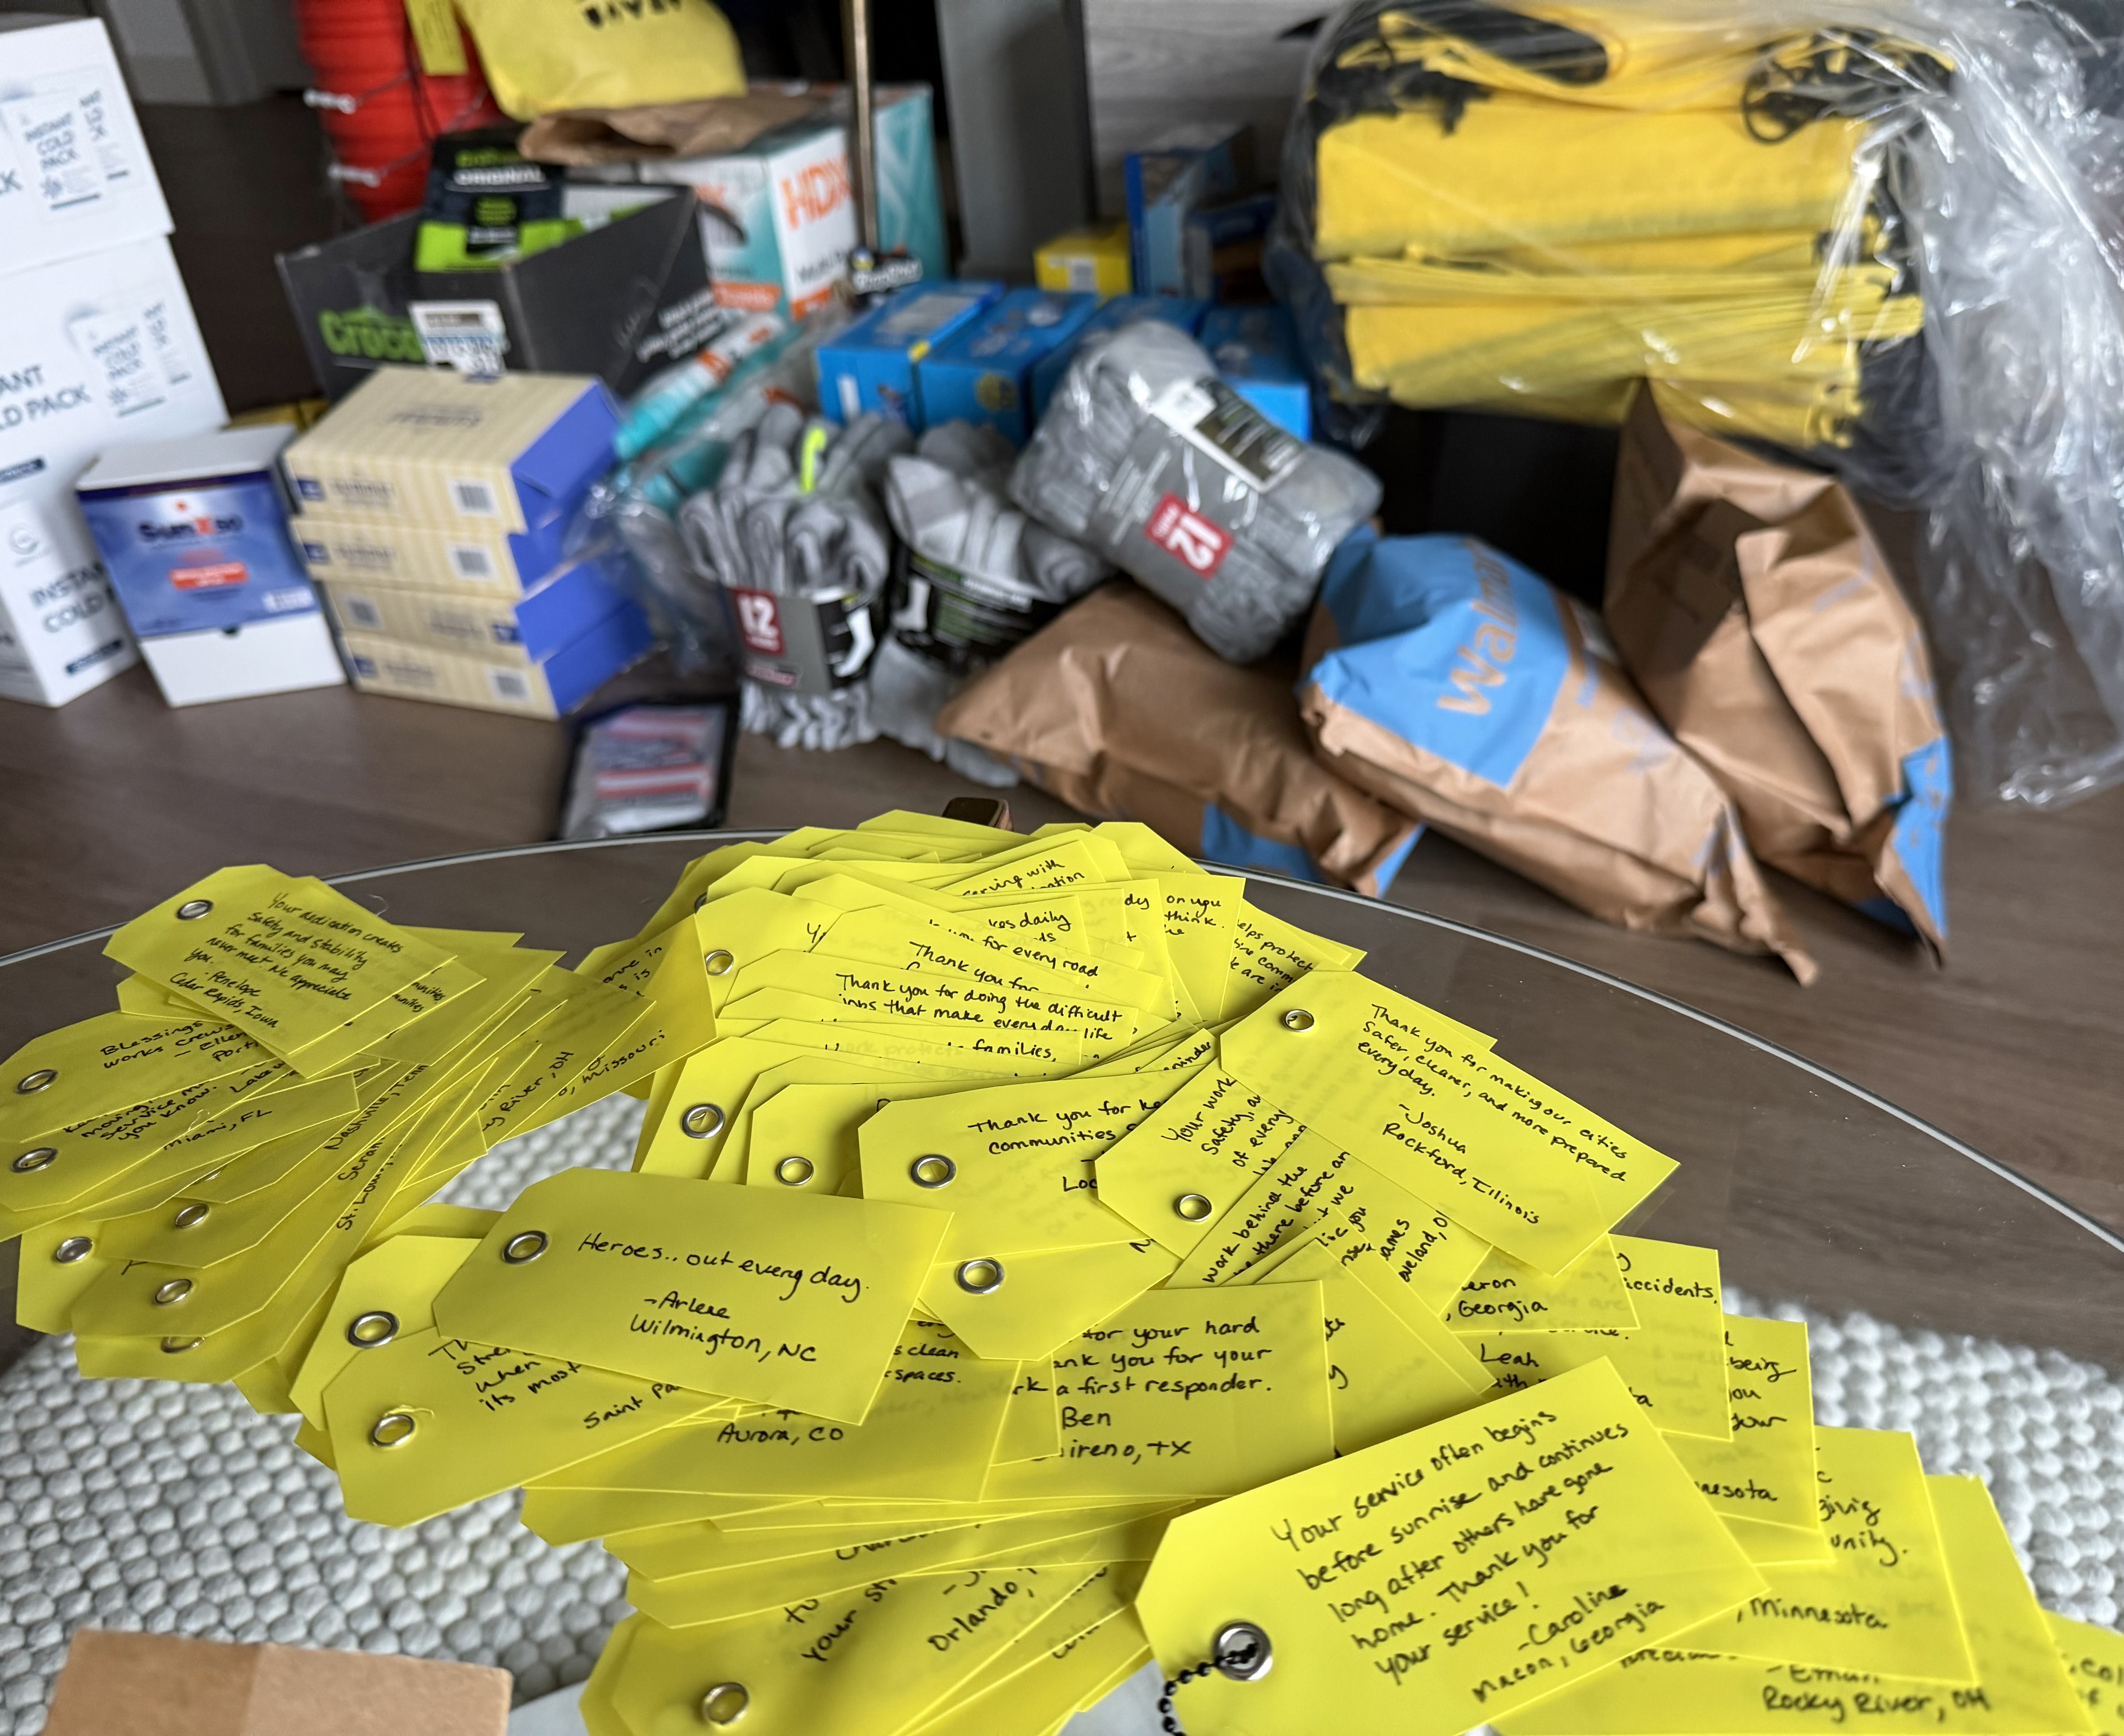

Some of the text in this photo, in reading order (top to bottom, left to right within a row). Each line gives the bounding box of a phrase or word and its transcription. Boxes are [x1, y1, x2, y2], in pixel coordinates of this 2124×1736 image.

[738, 593, 778, 636] 12
[1026, 859, 1065, 877] with
[1166, 895, 1185, 904] on
[271, 894, 403, 953] Your dedication creates
[1019, 911, 1072, 932] daily
[206, 937, 237, 953] never
[290, 975, 352, 1000] appreciate
[225, 924, 348, 982] for families you may
[282, 931, 312, 943] and
[310, 939, 368, 969] stability
[645, 947, 662, 957] in
[909, 941, 1003, 986] Thank you
[982, 935, 1098, 977] for every road
[633, 968, 650, 981] is
[1241, 969, 1265, 984] are
[170, 973, 279, 1028] Cedar Rapids, Iowa
[835, 973, 1123, 1022] Thank you for doing the difficult
[100, 1020, 203, 1056] Blessings
[883, 999, 1113, 1040] that make life
[103, 1023, 237, 1069] works crews
[1373, 1005, 1627, 1159] Thank you for making our cities
[100, 1099, 176, 1140] service
[118, 1122, 157, 1140] you
[157, 1086, 217, 1118] know.
[240, 1110, 272, 1122] FL
[325, 1092, 400, 1150] Nashville,
[967, 1100, 1131, 1133] Thank you for
[1162, 1078, 1238, 1141] Your work
[1415, 1055, 1471, 1097] cleaner,
[1478, 1092, 1508, 1112] and
[1511, 1111, 1549, 1135] more
[1550, 1135, 1626, 1182] prepared
[989, 1129, 1116, 1155] communities
[1382, 1122, 1539, 1224] Rockford, Illinois
[1252, 1219, 1294, 1255] there
[1284, 1171, 1335, 1213] before
[1330, 1185, 1354, 1206] we
[1202, 1243, 1240, 1283] work
[1232, 1191, 1282, 1239] behind
[1277, 1166, 1308, 1187] the
[1380, 1220, 1410, 1261] ames
[686, 1251, 734, 1266] out
[1458, 1300, 1548, 1322] Georgia
[630, 1314, 816, 1363] Wilmington, NC
[907, 1343, 959, 1359] clean
[1132, 1327, 1190, 1349] your
[1205, 1316, 1260, 1335] hard
[895, 1369, 961, 1383] spaces.
[1111, 1346, 1272, 1373] you for your
[1480, 1343, 1539, 1368] Leah
[475, 1361, 541, 1393] when
[479, 1361, 582, 1411] its most
[1056, 1372, 1271, 1400] a first responder.
[583, 1396, 643, 1429] Saint
[1062, 1406, 1111, 1430] Ben
[717, 1422, 844, 1446] Aurora, CO
[1274, 1411, 1557, 1550] Your service often begins
[1297, 1424, 1628, 1590] before sunrise and continues
[1328, 1462, 1613, 1623] long after others have gone
[1351, 1505, 1598, 1649] home. Thank you for
[927, 1583, 1034, 1651] Orlando,
[1443, 1583, 1539, 1647] service!
[1518, 1585, 1628, 1650] -Caroline
[1571, 1602, 1665, 1653] Georgia
[1750, 1598, 1887, 1629] Minnesota
[1763, 1686, 1845, 1723] Rocky
